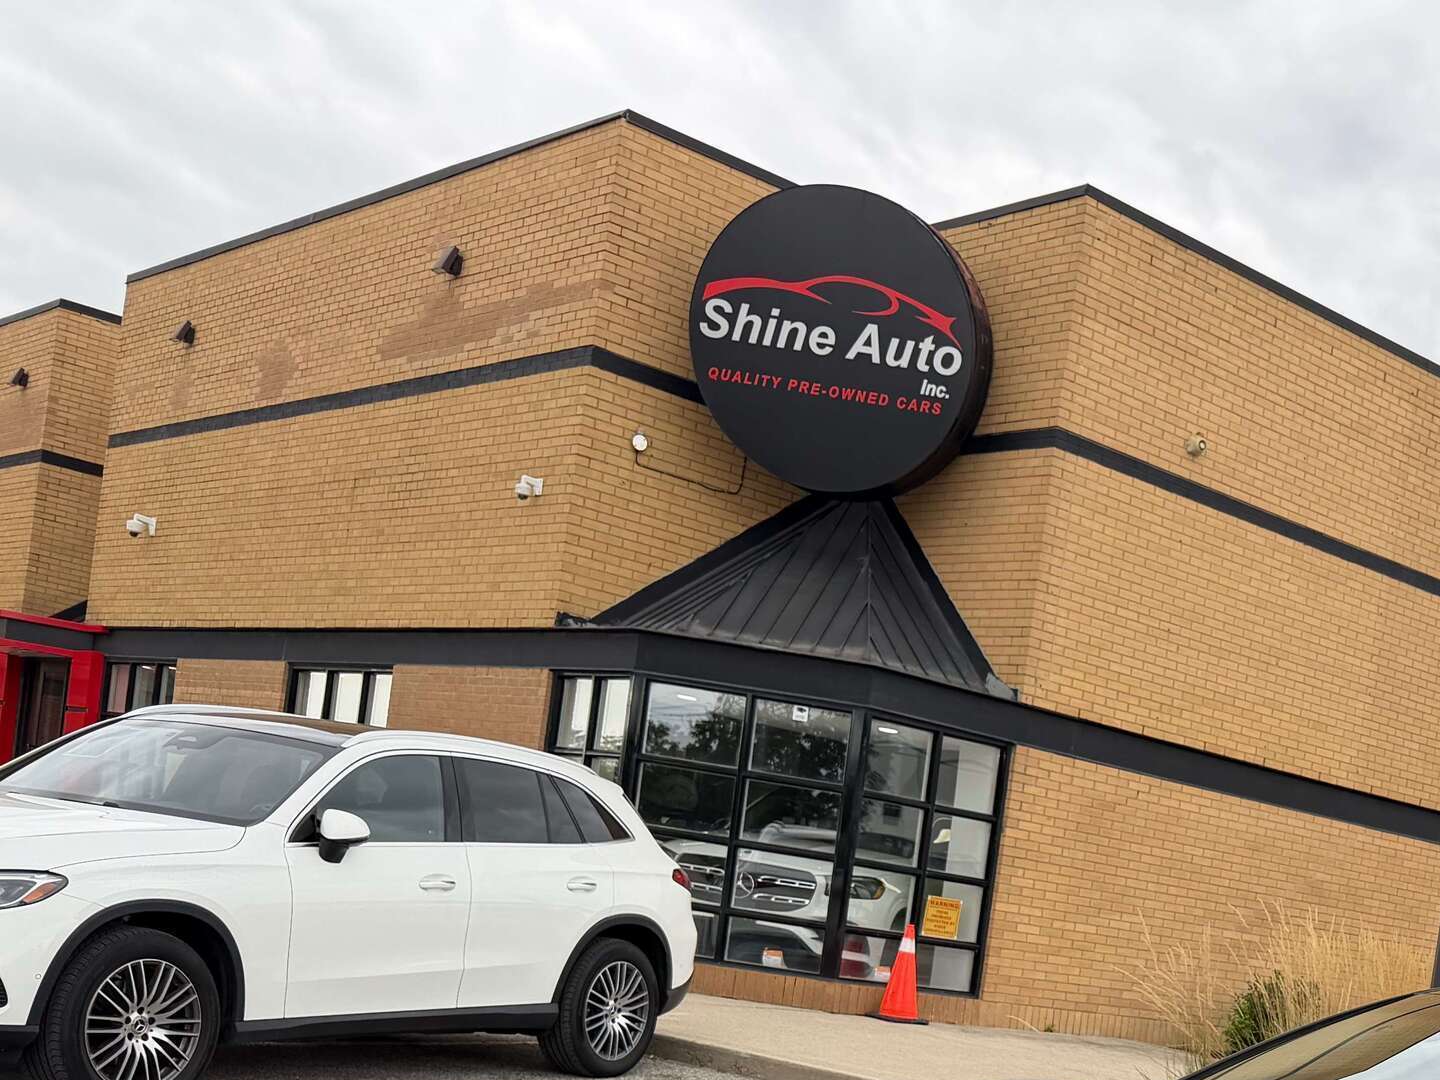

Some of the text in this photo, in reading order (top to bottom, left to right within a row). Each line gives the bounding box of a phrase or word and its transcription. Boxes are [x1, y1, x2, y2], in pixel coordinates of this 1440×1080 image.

[700, 299, 962, 376] Shine Auto
[708, 367, 942, 415] QUALITY PRE-OWNED CARS
[920, 379, 950, 399] Inc.
